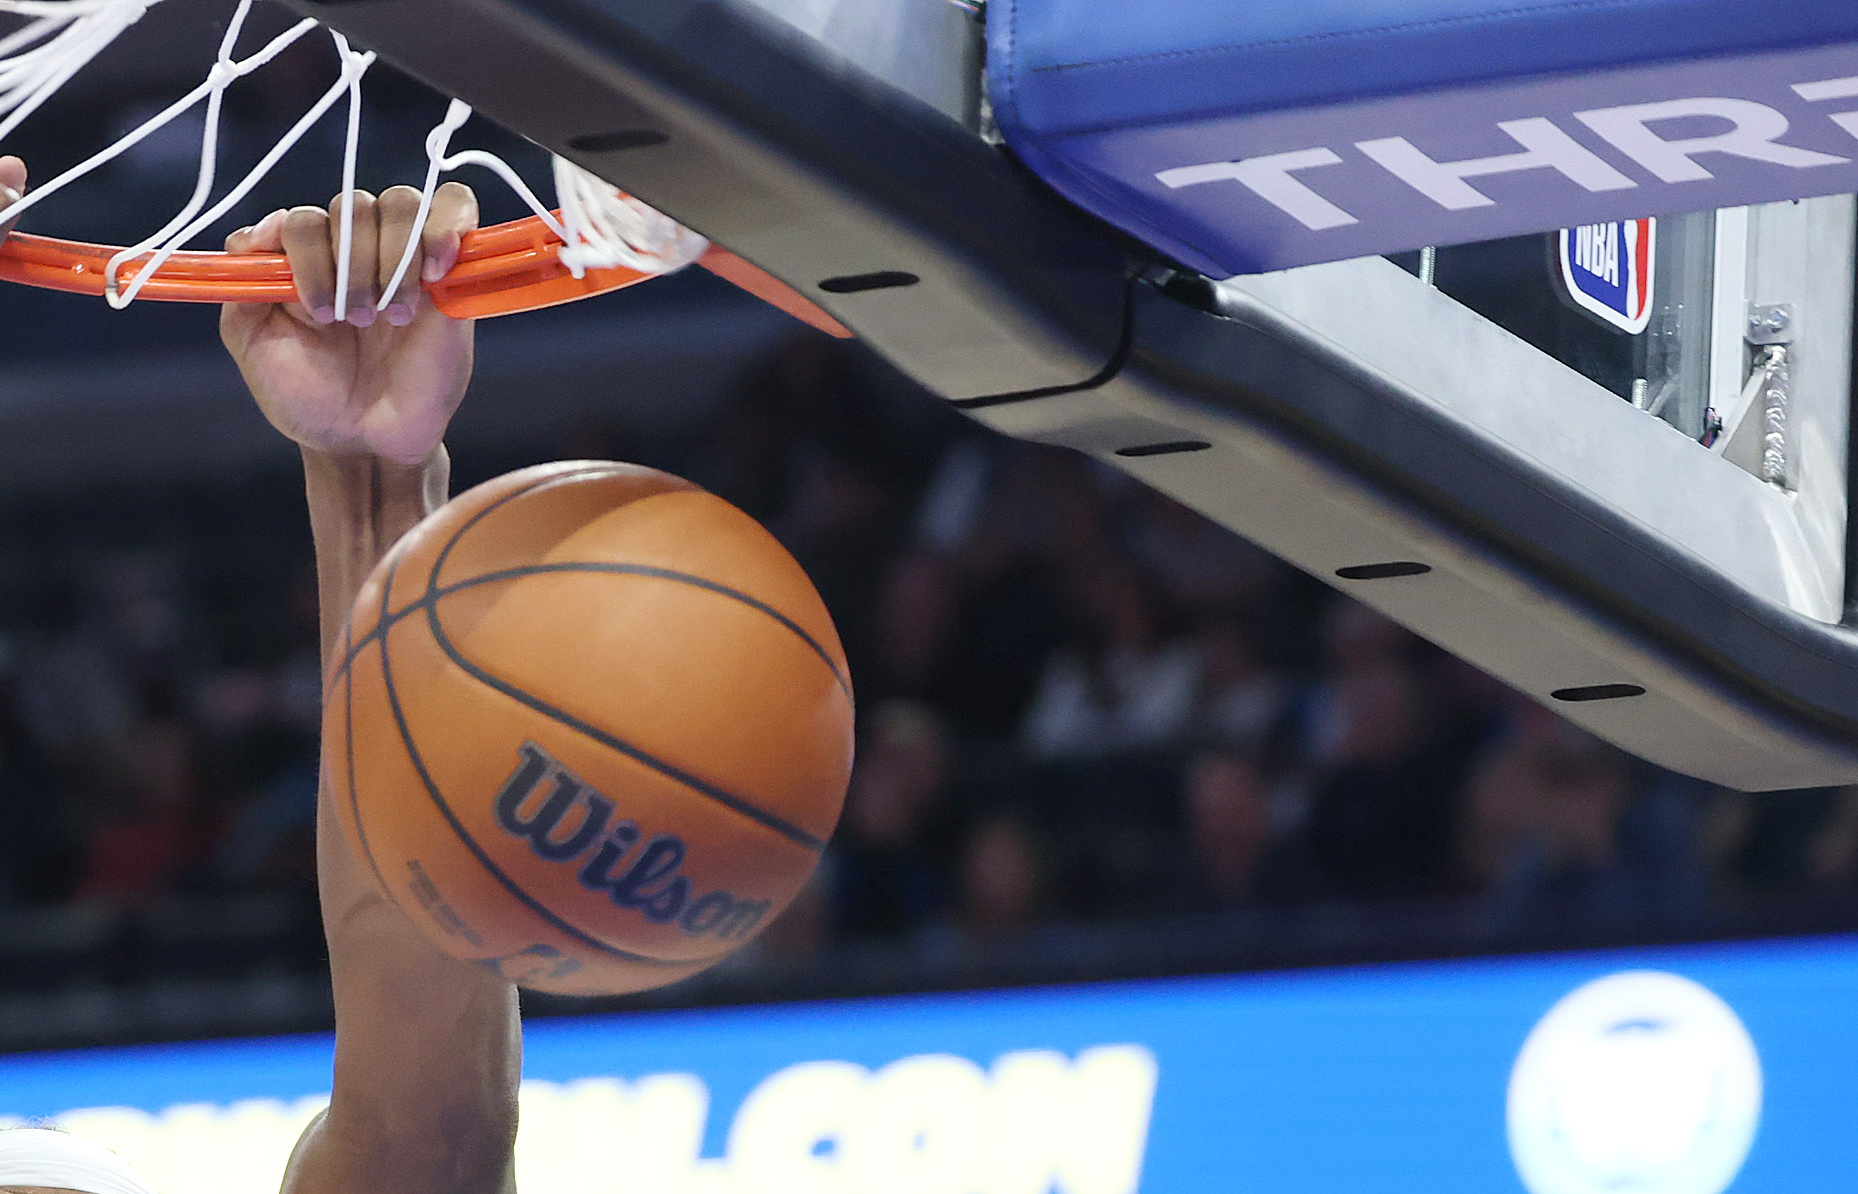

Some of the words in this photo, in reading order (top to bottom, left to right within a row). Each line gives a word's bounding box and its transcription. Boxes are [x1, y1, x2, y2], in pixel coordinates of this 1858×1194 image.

[1155, 75, 1858, 231] THR
[1575, 221, 1619, 288] NBA
[492, 739, 772, 940] Wilson
